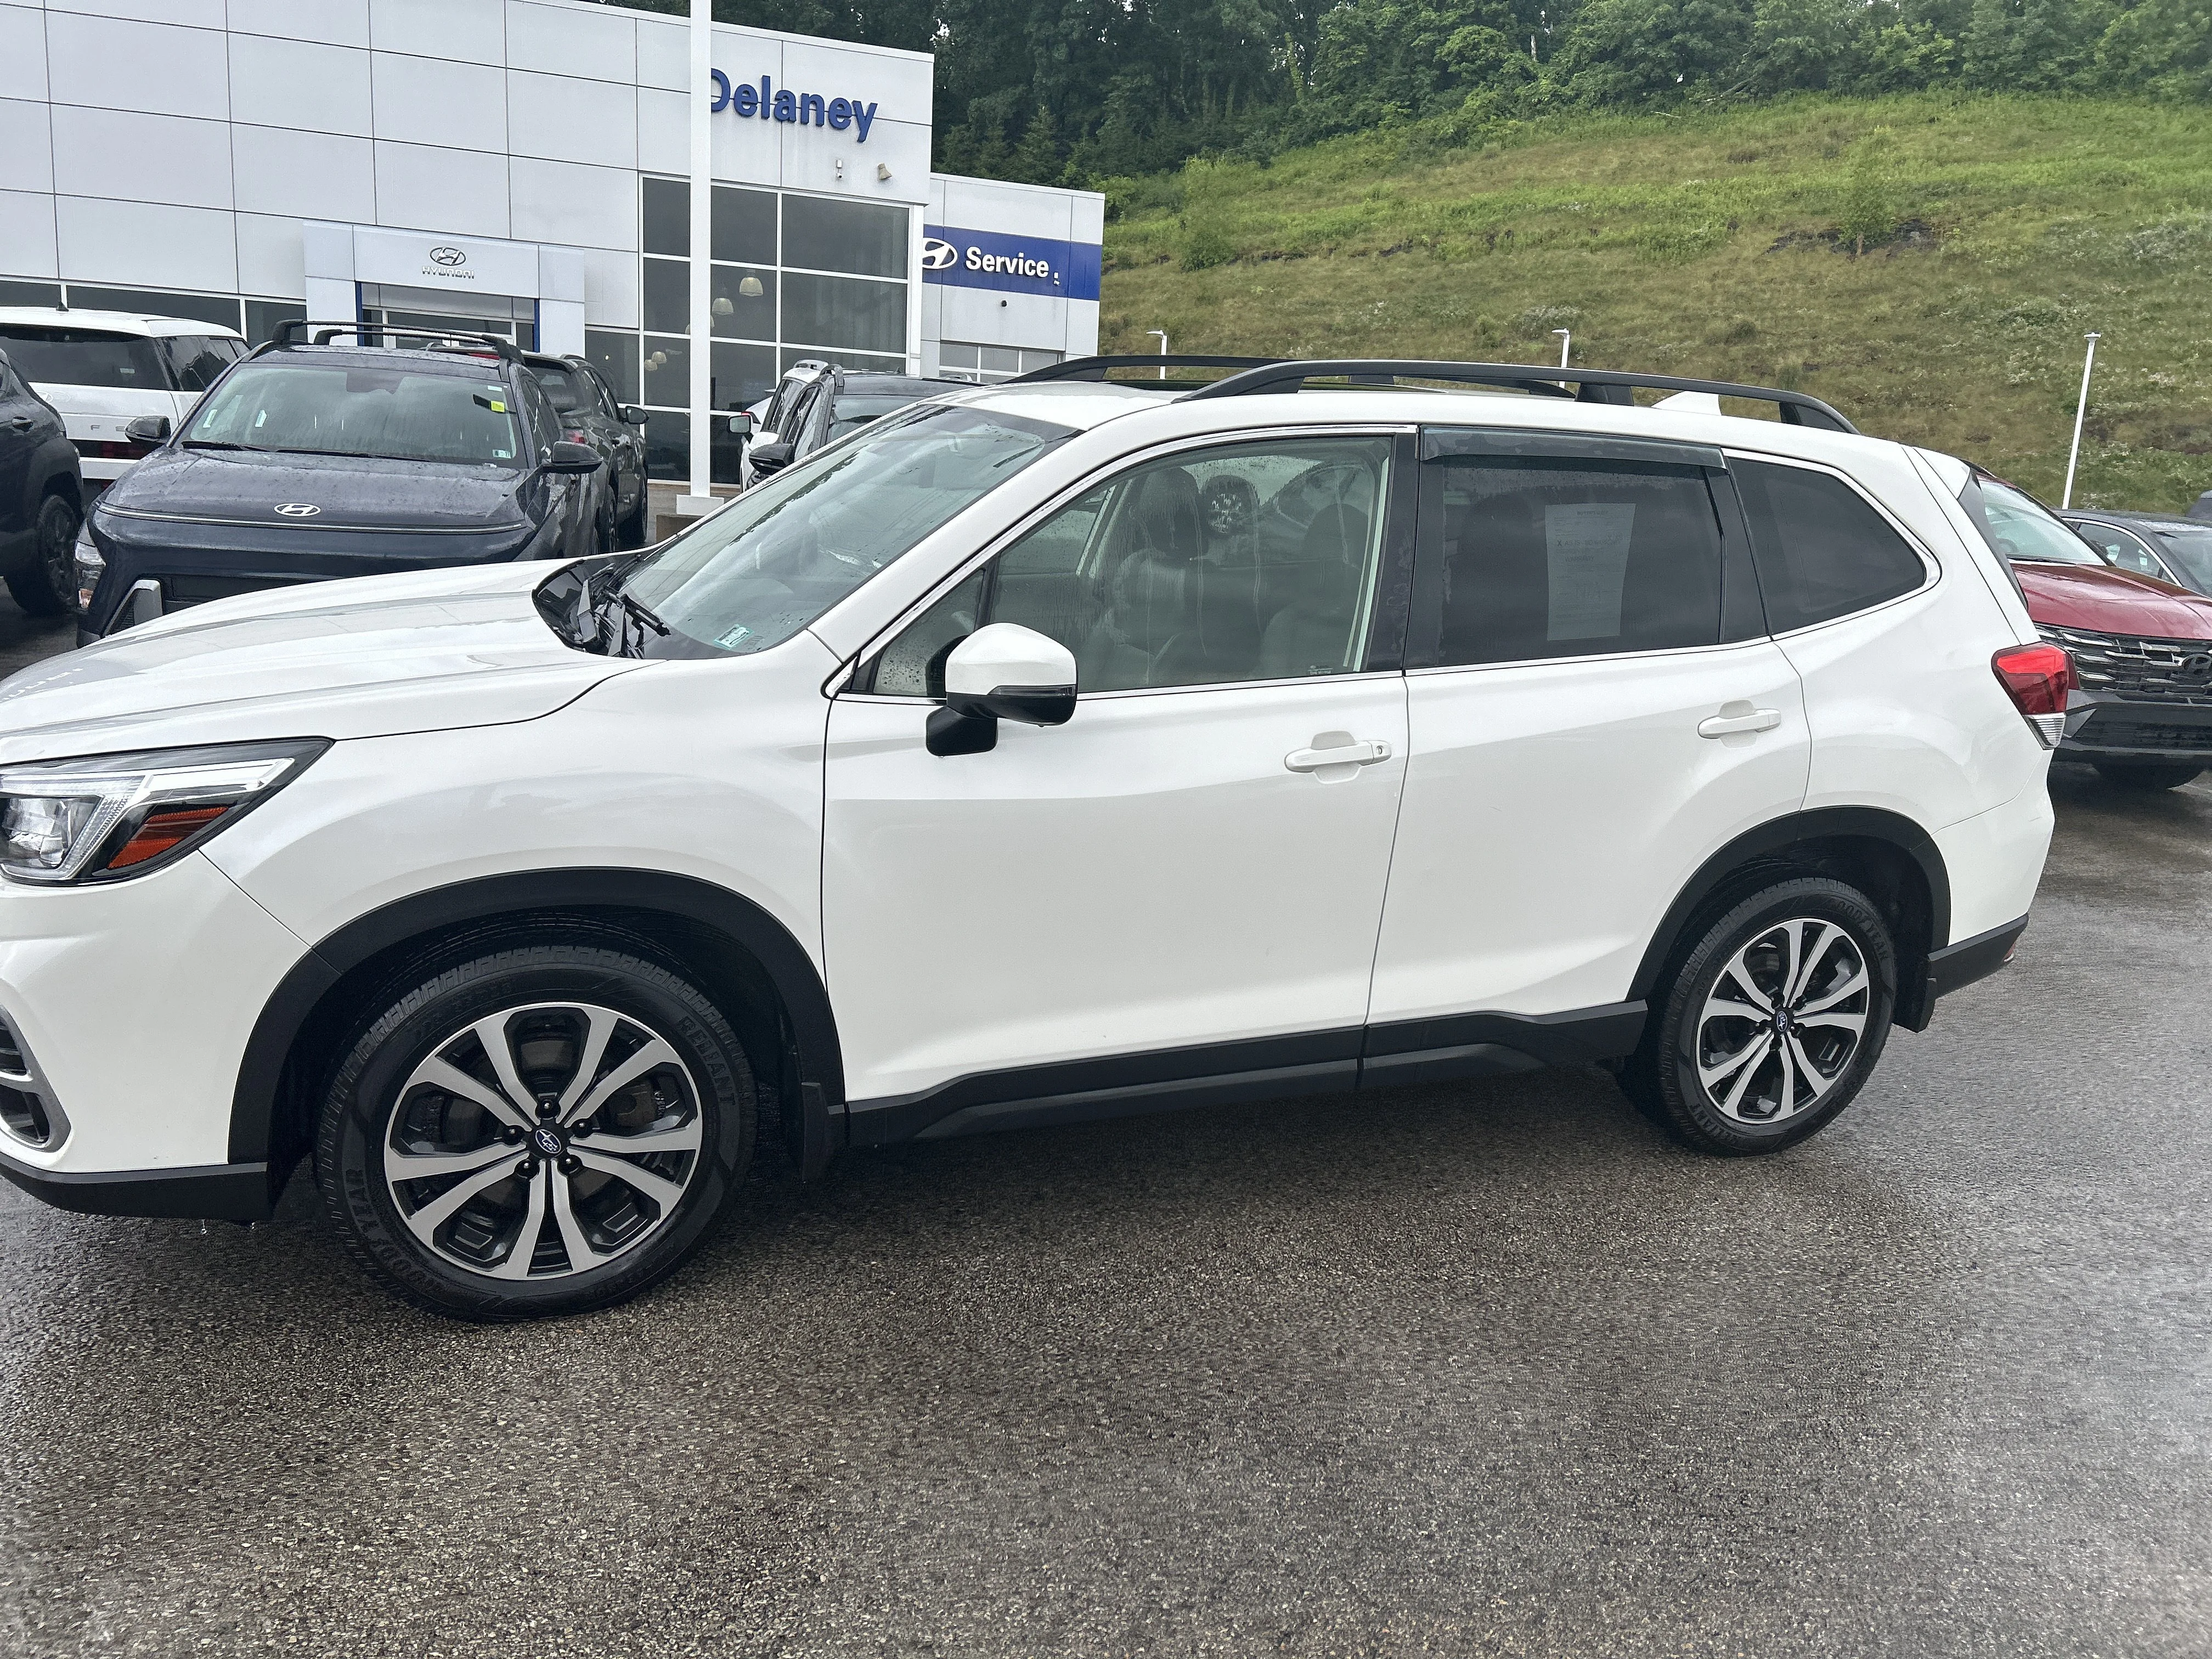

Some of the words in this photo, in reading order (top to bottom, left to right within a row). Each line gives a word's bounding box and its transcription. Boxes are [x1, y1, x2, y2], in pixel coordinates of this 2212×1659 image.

[711, 68, 878, 143] Delaney
[422, 266, 475, 279] HYUNDAI
[966, 246, 1049, 278] Service
[675, 1015, 736, 1107] RELIANT
